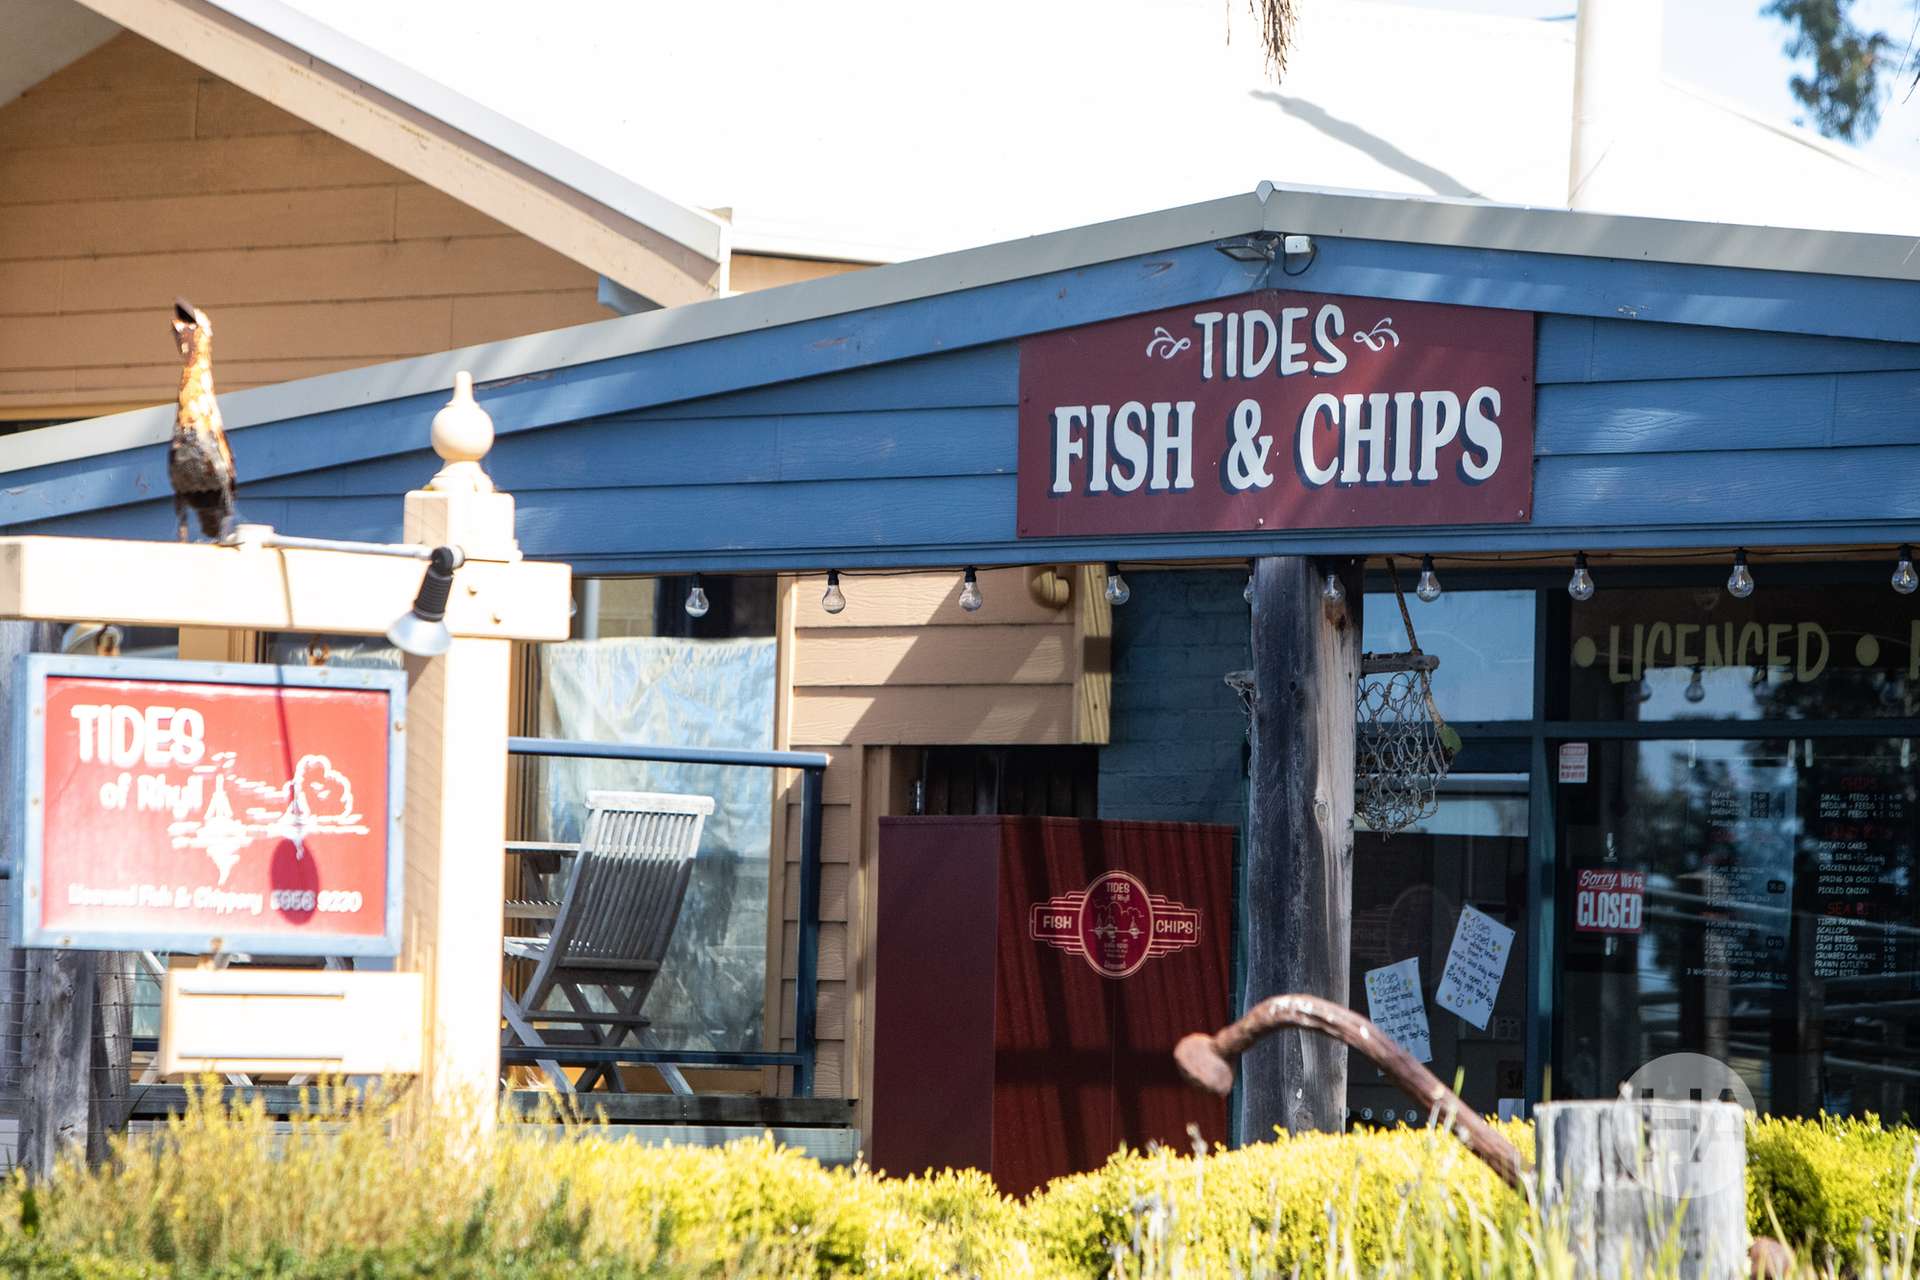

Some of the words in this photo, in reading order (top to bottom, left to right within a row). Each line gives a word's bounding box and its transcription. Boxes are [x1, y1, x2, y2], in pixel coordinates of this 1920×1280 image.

[1194, 303, 1348, 379] TIDES
[1051, 400, 1196, 494] FISH
[1226, 398, 1274, 490] &
[1298, 386, 1502, 486] CHIPS
[1609, 621, 1830, 685] LICENCED
[70, 703, 206, 768] TIDES
[99, 771, 132, 811] of
[1105, 882, 1130, 894] TIDES
[1579, 870, 1618, 890] Sorry
[1620, 872, 1643, 889] We're
[1043, 914, 1073, 929] FISH
[1155, 918, 1194, 934] CHIPS
[1576, 890, 1643, 929] CLOSED
